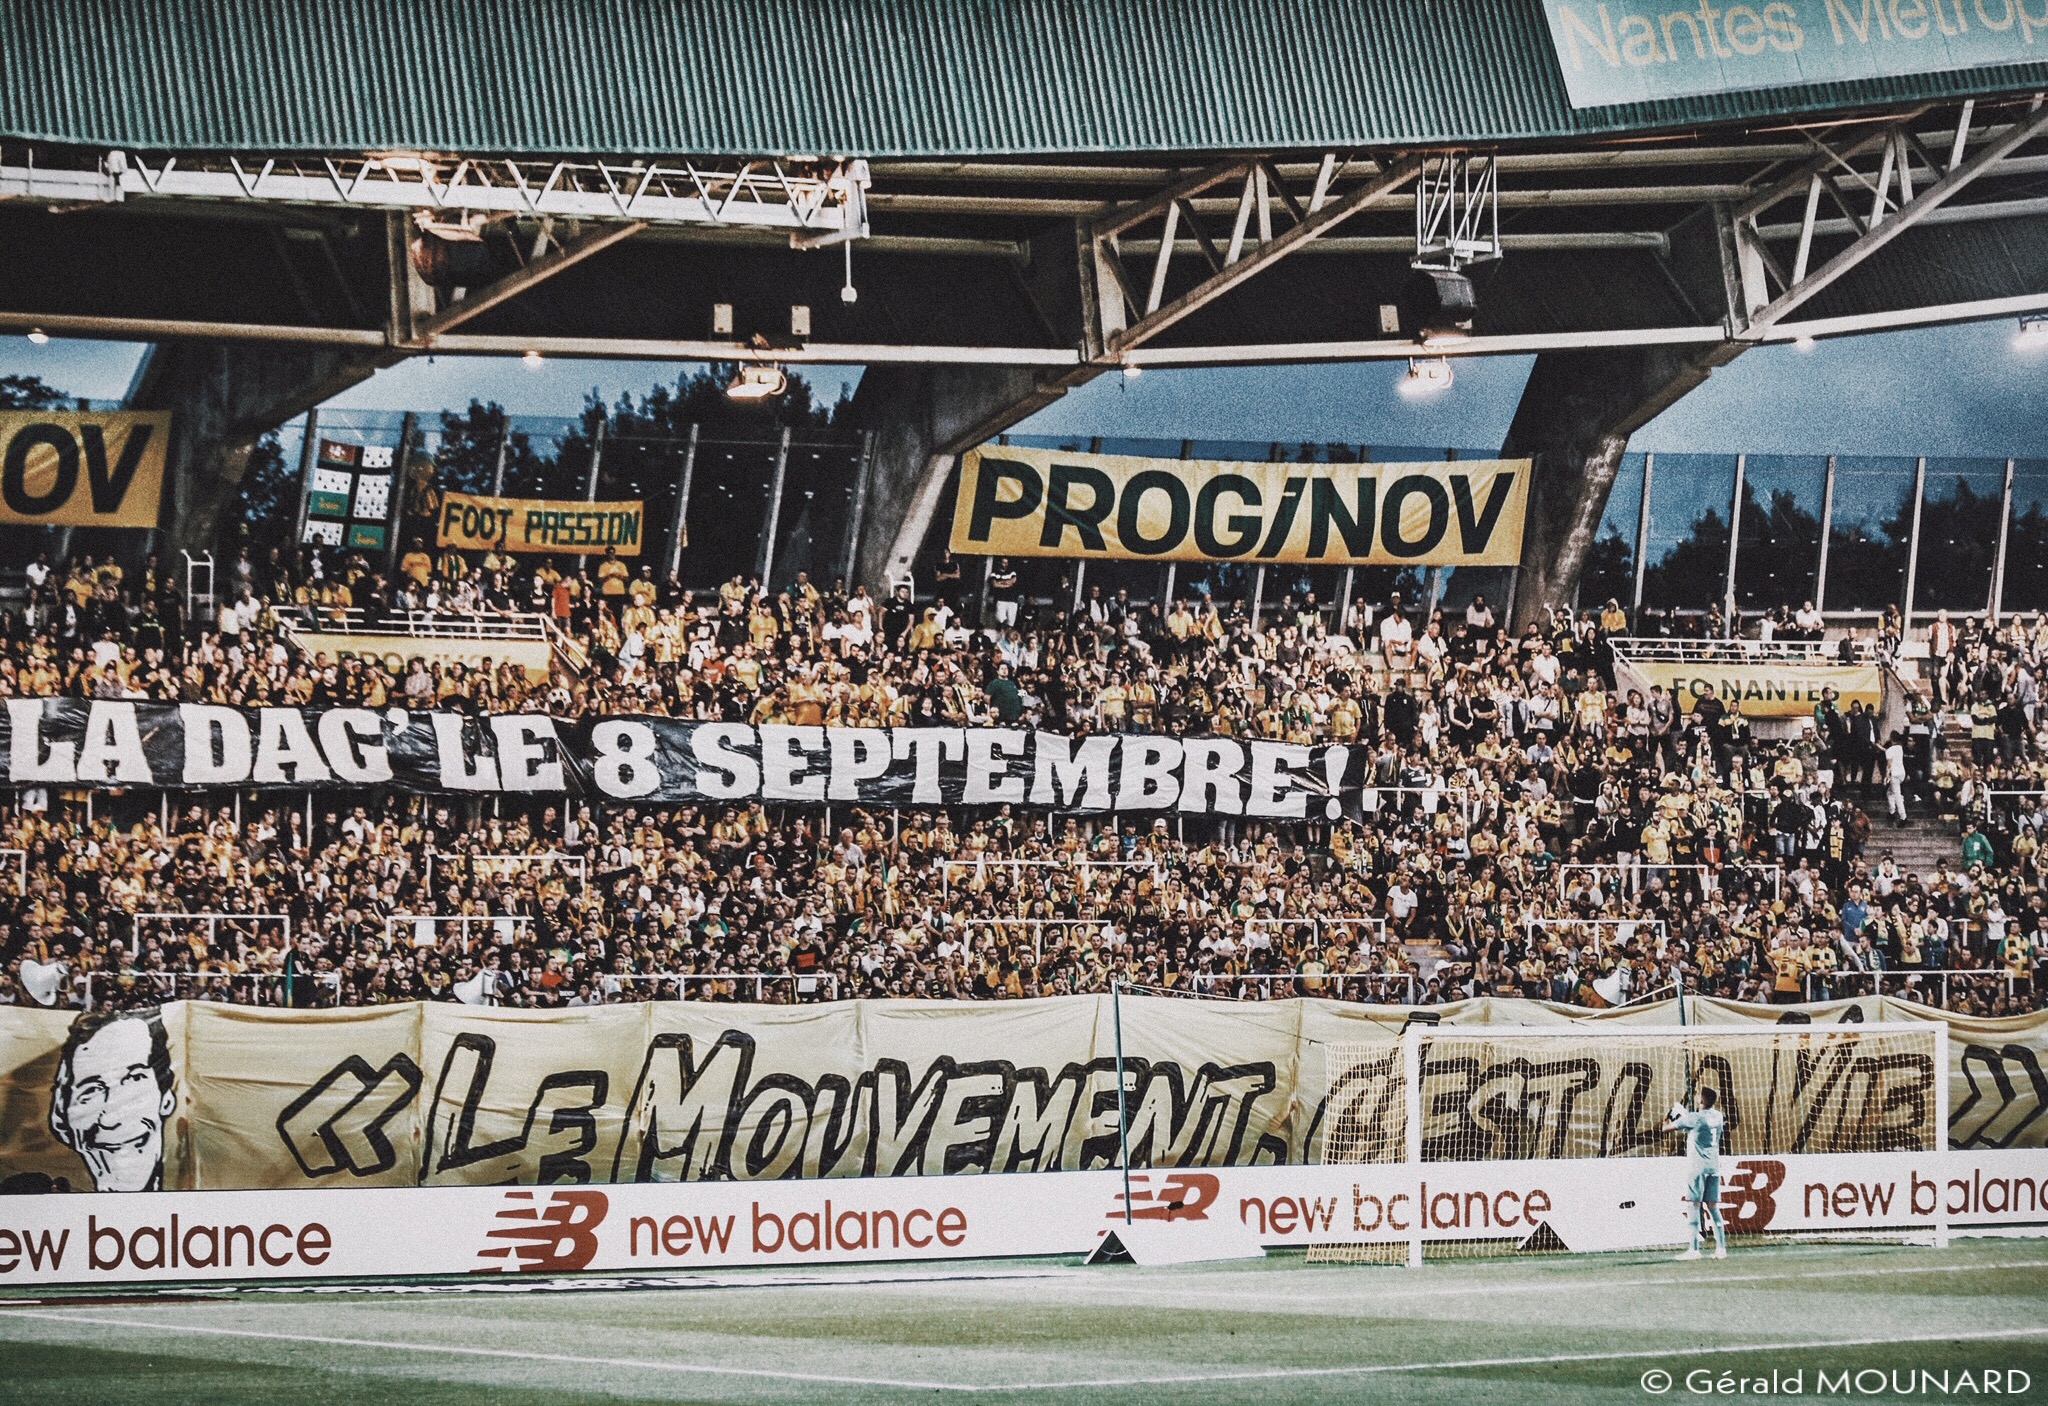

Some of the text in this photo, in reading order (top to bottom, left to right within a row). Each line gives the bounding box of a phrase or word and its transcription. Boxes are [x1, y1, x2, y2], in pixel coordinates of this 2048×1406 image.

[1558, 1, 1804, 69] Nantes
[2, 422, 155, 515] OV
[441, 502, 640, 546] FOOT PASSION
[1721, 679, 1840, 702] NANTES
[8, 699, 153, 784] LA
[431, 711, 566, 792] LE
[592, 719, 661, 798] 8
[1239, 1197, 1338, 1235] new
[1804, 1168, 2048, 1218] new balan
[88, 1213, 333, 1271] balance
[630, 1200, 968, 1257] new balance
